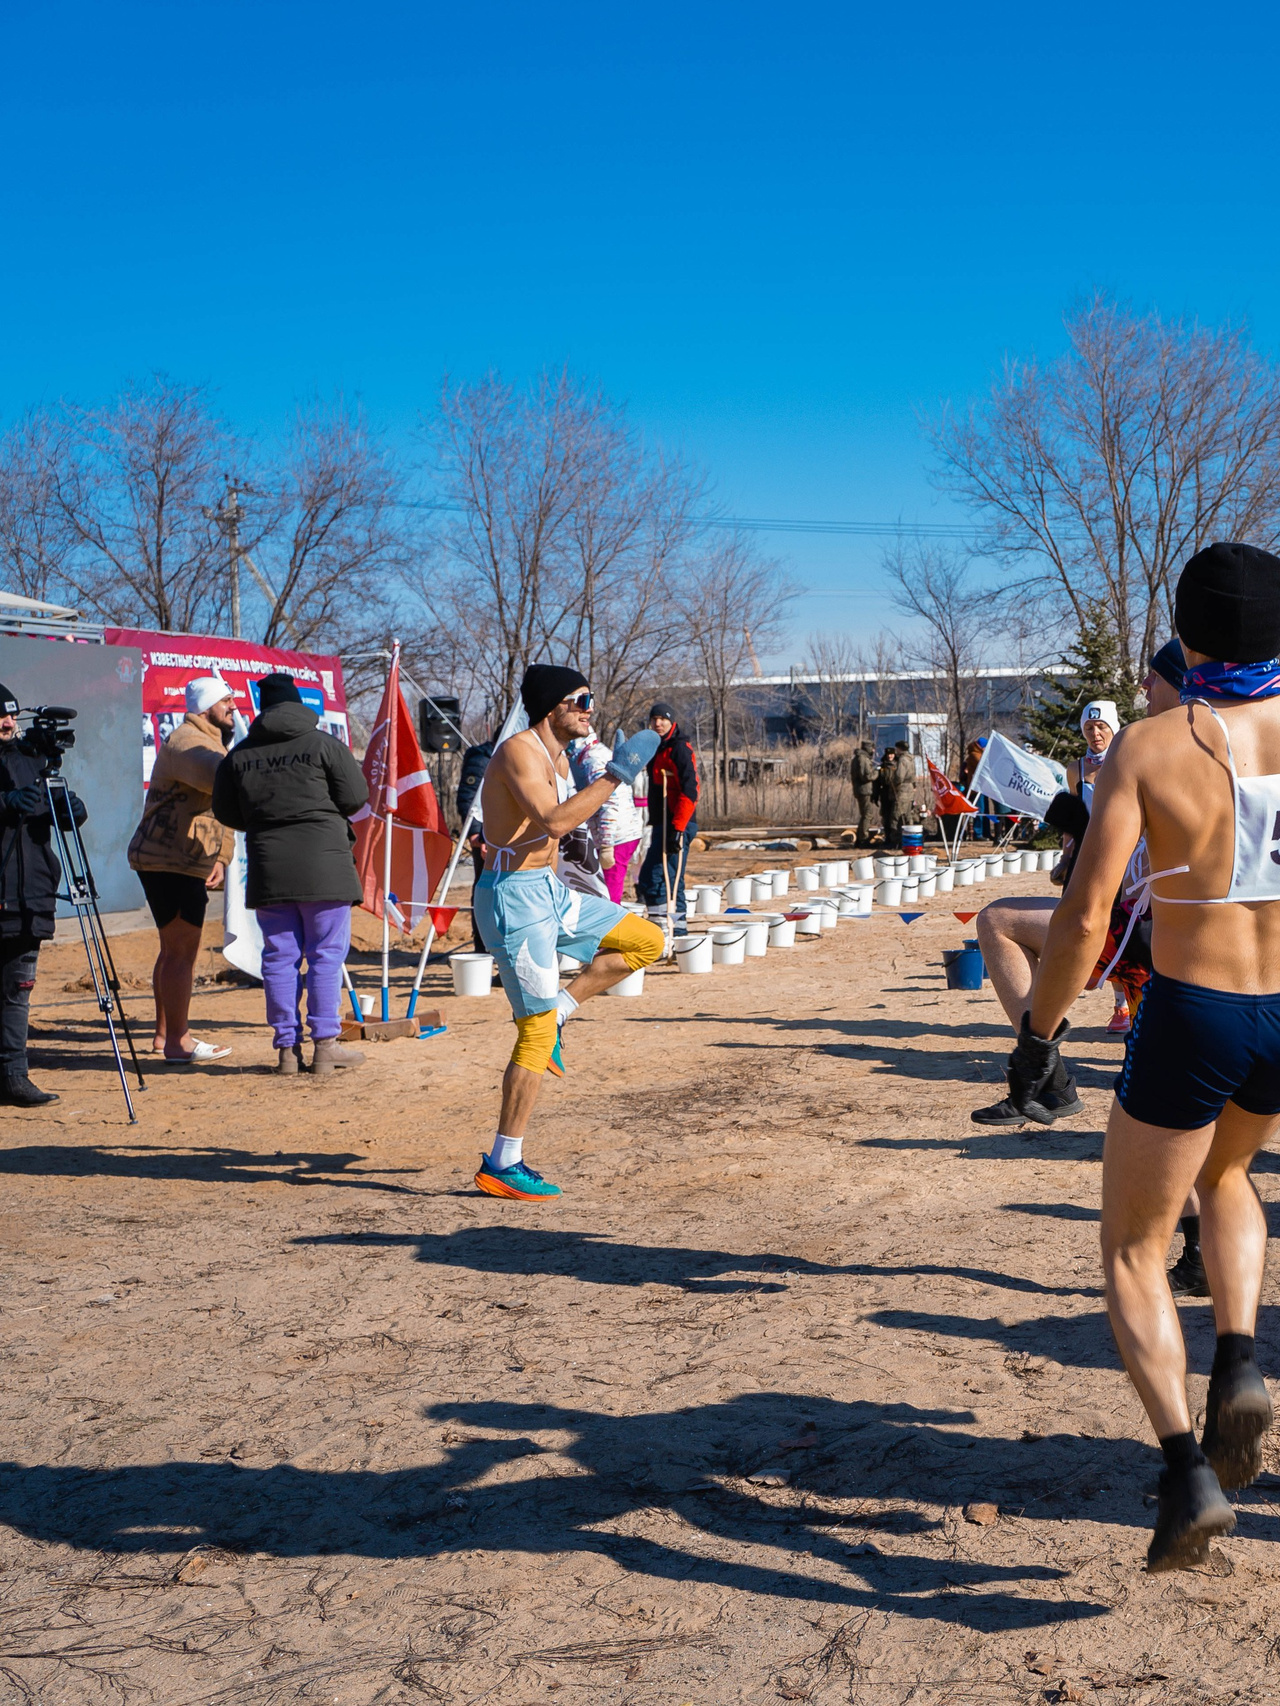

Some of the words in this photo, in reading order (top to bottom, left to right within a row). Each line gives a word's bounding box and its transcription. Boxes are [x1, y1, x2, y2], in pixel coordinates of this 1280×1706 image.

[150, 652, 193, 668] ИЗВЕСТНЫЕ
[193, 655, 241, 671] СПОРТСМЕНЫ
[240, 659, 251, 672] НА
[234, 758, 263, 774] LIFE
[266, 752, 311, 769] WEAR
